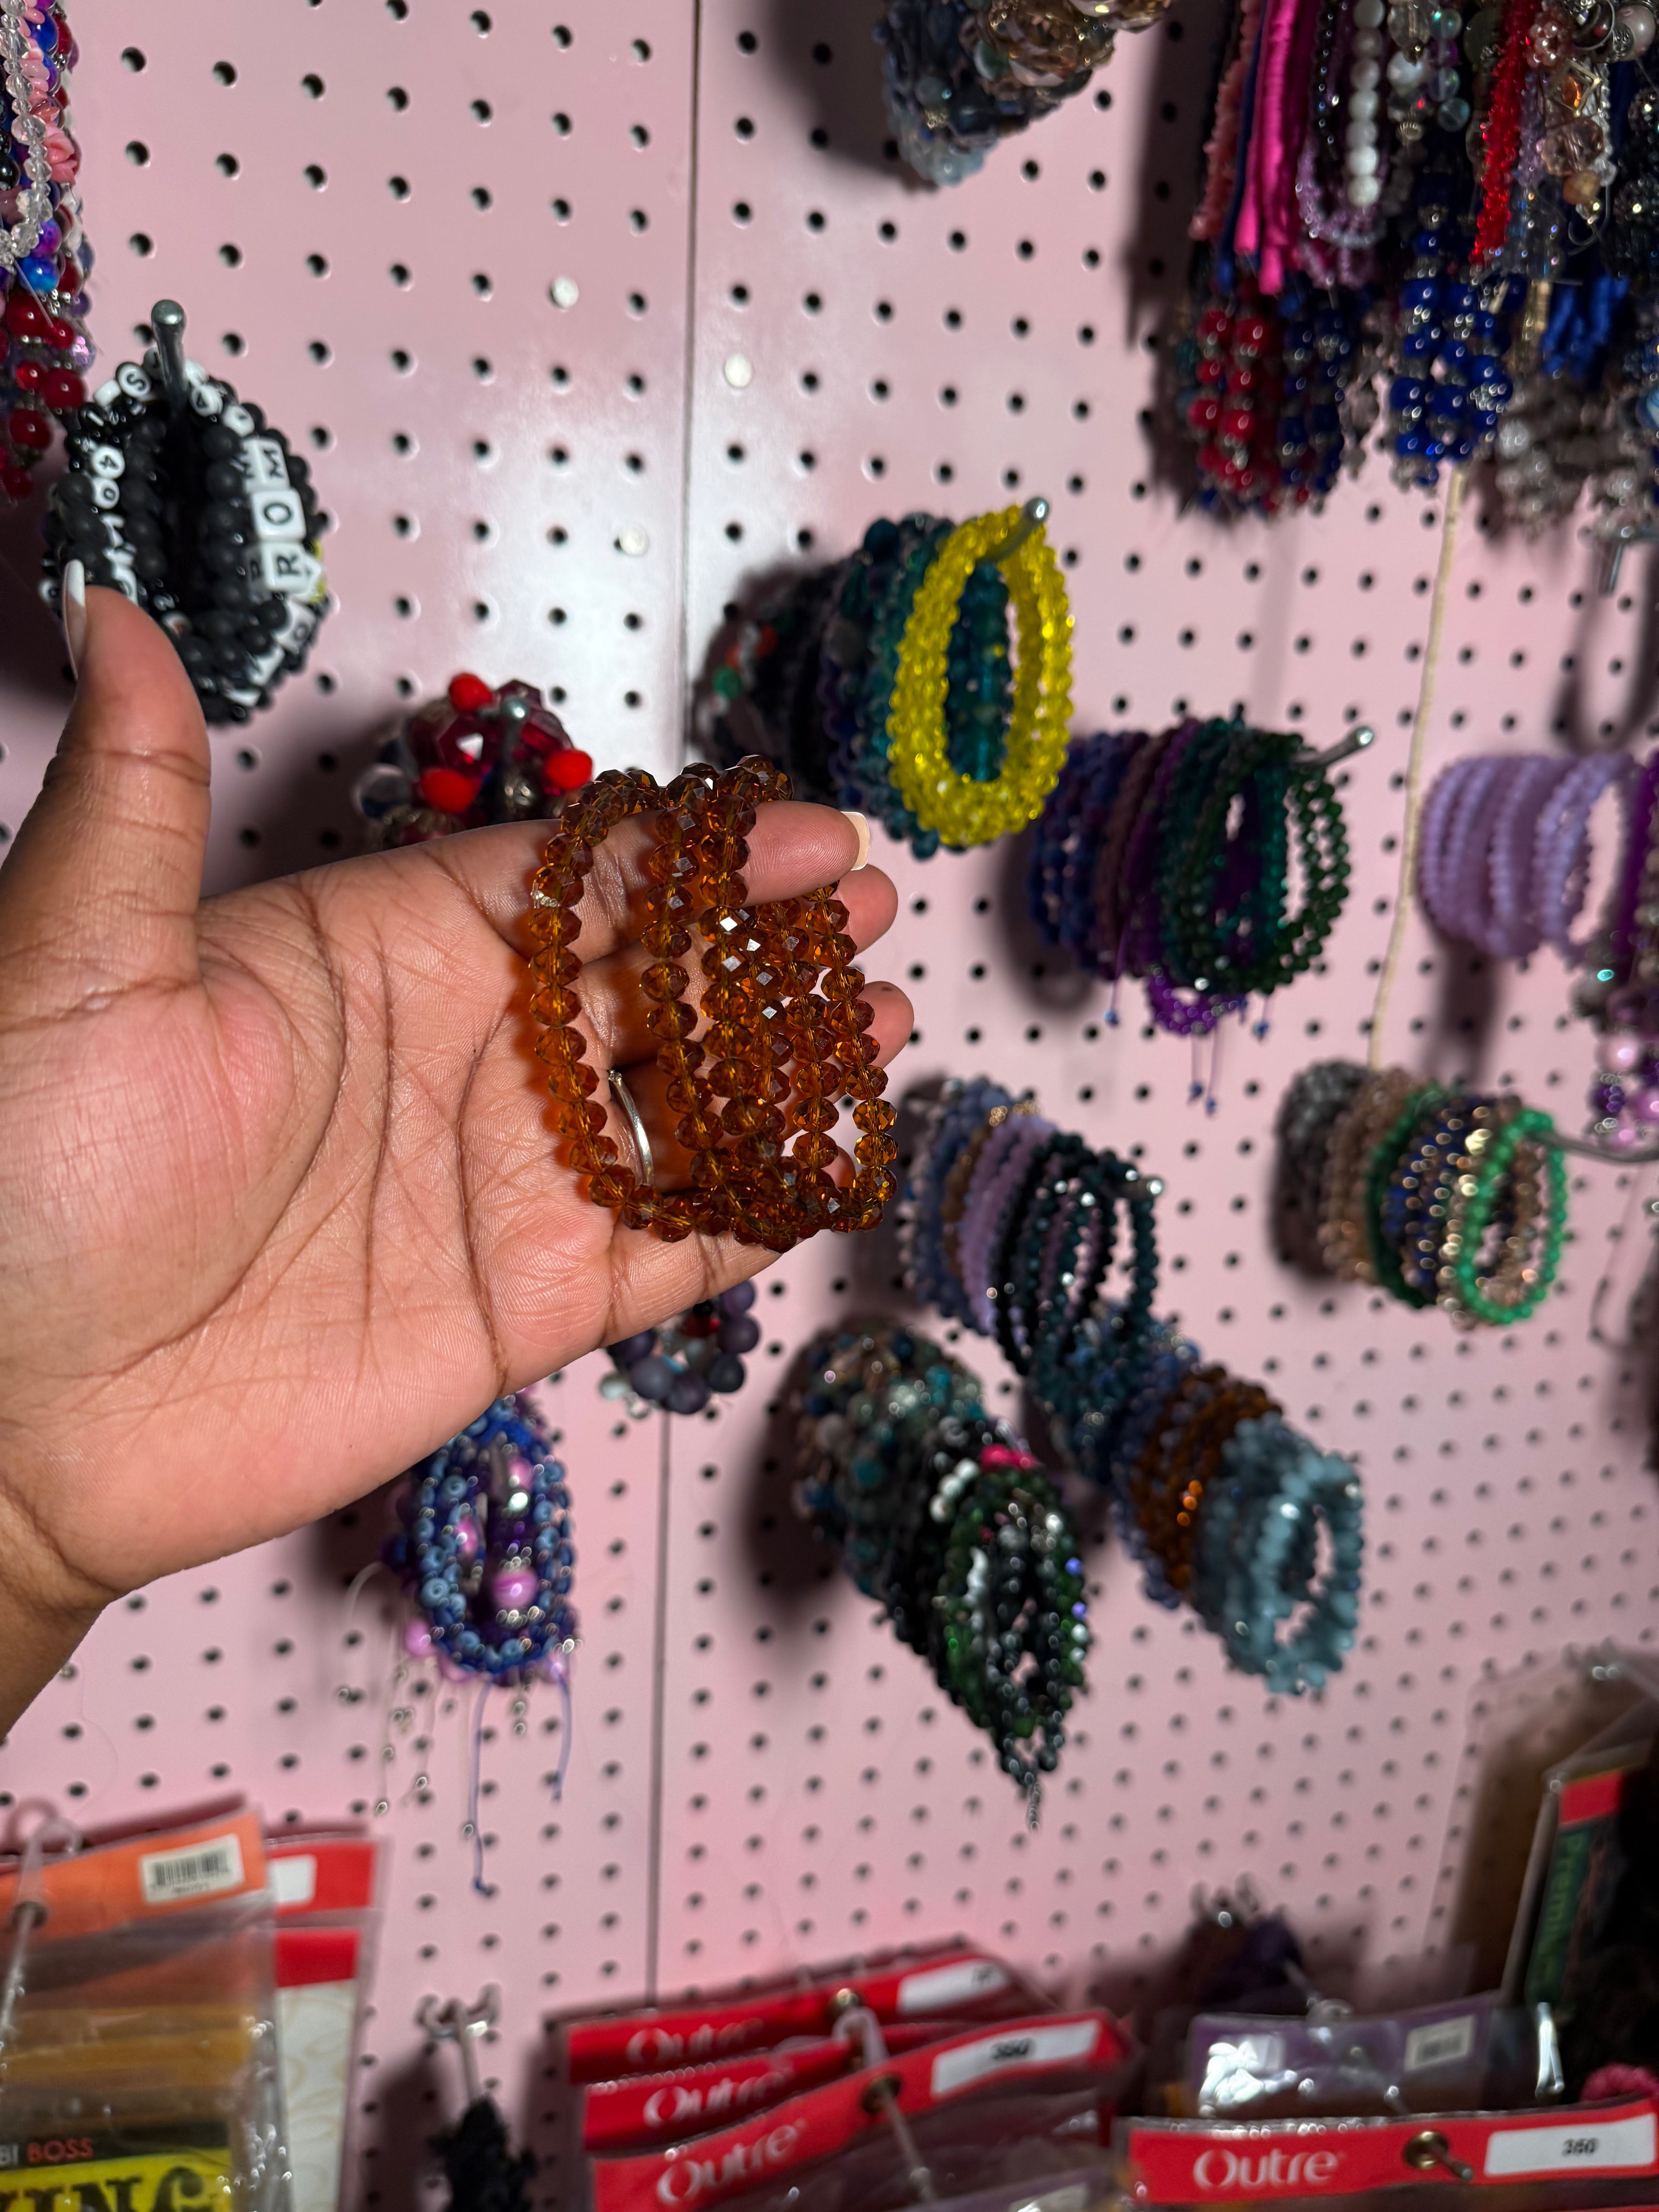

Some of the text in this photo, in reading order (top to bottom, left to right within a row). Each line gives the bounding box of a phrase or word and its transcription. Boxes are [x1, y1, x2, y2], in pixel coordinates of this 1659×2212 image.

[26, 2138, 93, 2164] BOSS
[657, 2125, 798, 2207] Outre
[1193, 2148, 1338, 2191] Outre
